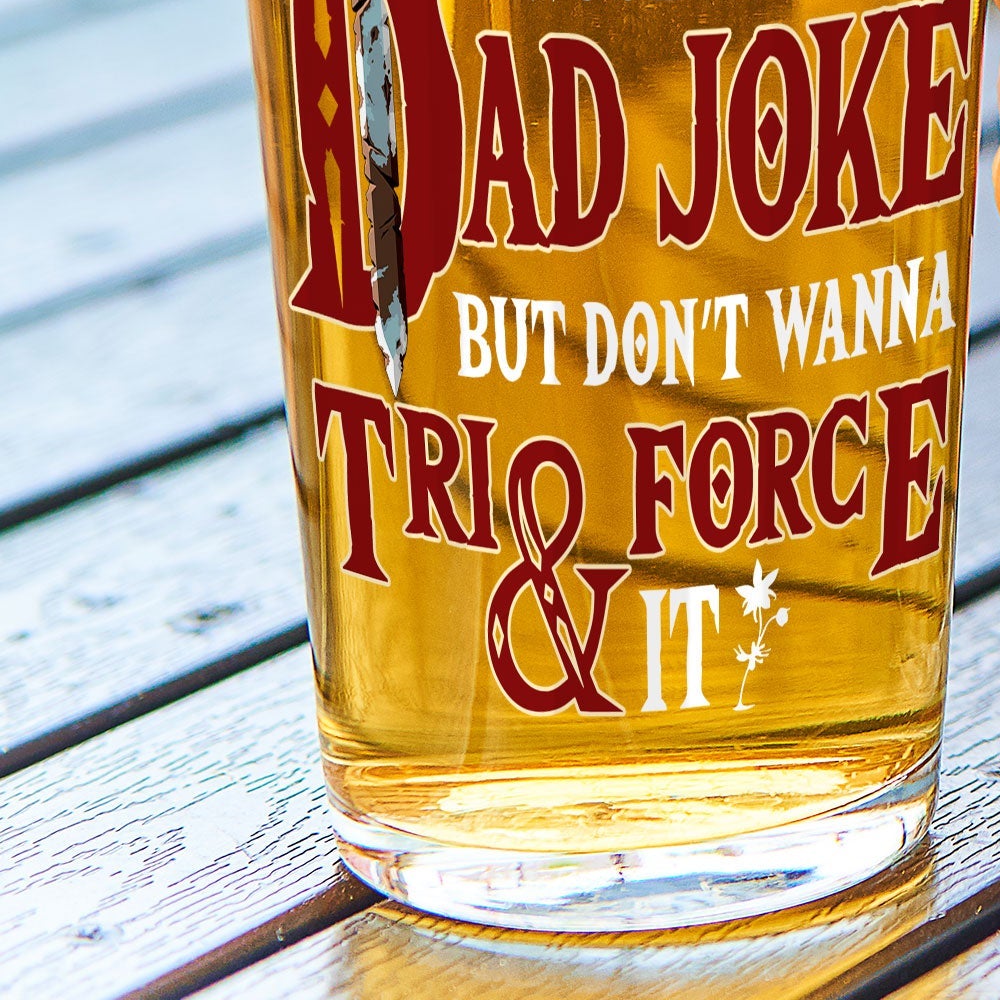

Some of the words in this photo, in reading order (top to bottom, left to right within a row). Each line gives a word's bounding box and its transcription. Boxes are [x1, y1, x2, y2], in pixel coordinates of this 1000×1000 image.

[453, 291, 567, 386] BUT
[583, 291, 750, 387] DON'T
[765, 250, 956, 372] WANNA
[312, 380, 500, 586] TRI
[485, 435, 632, 717] &
[626, 366, 952, 580] FORCE
[640, 584, 720, 713] IT
